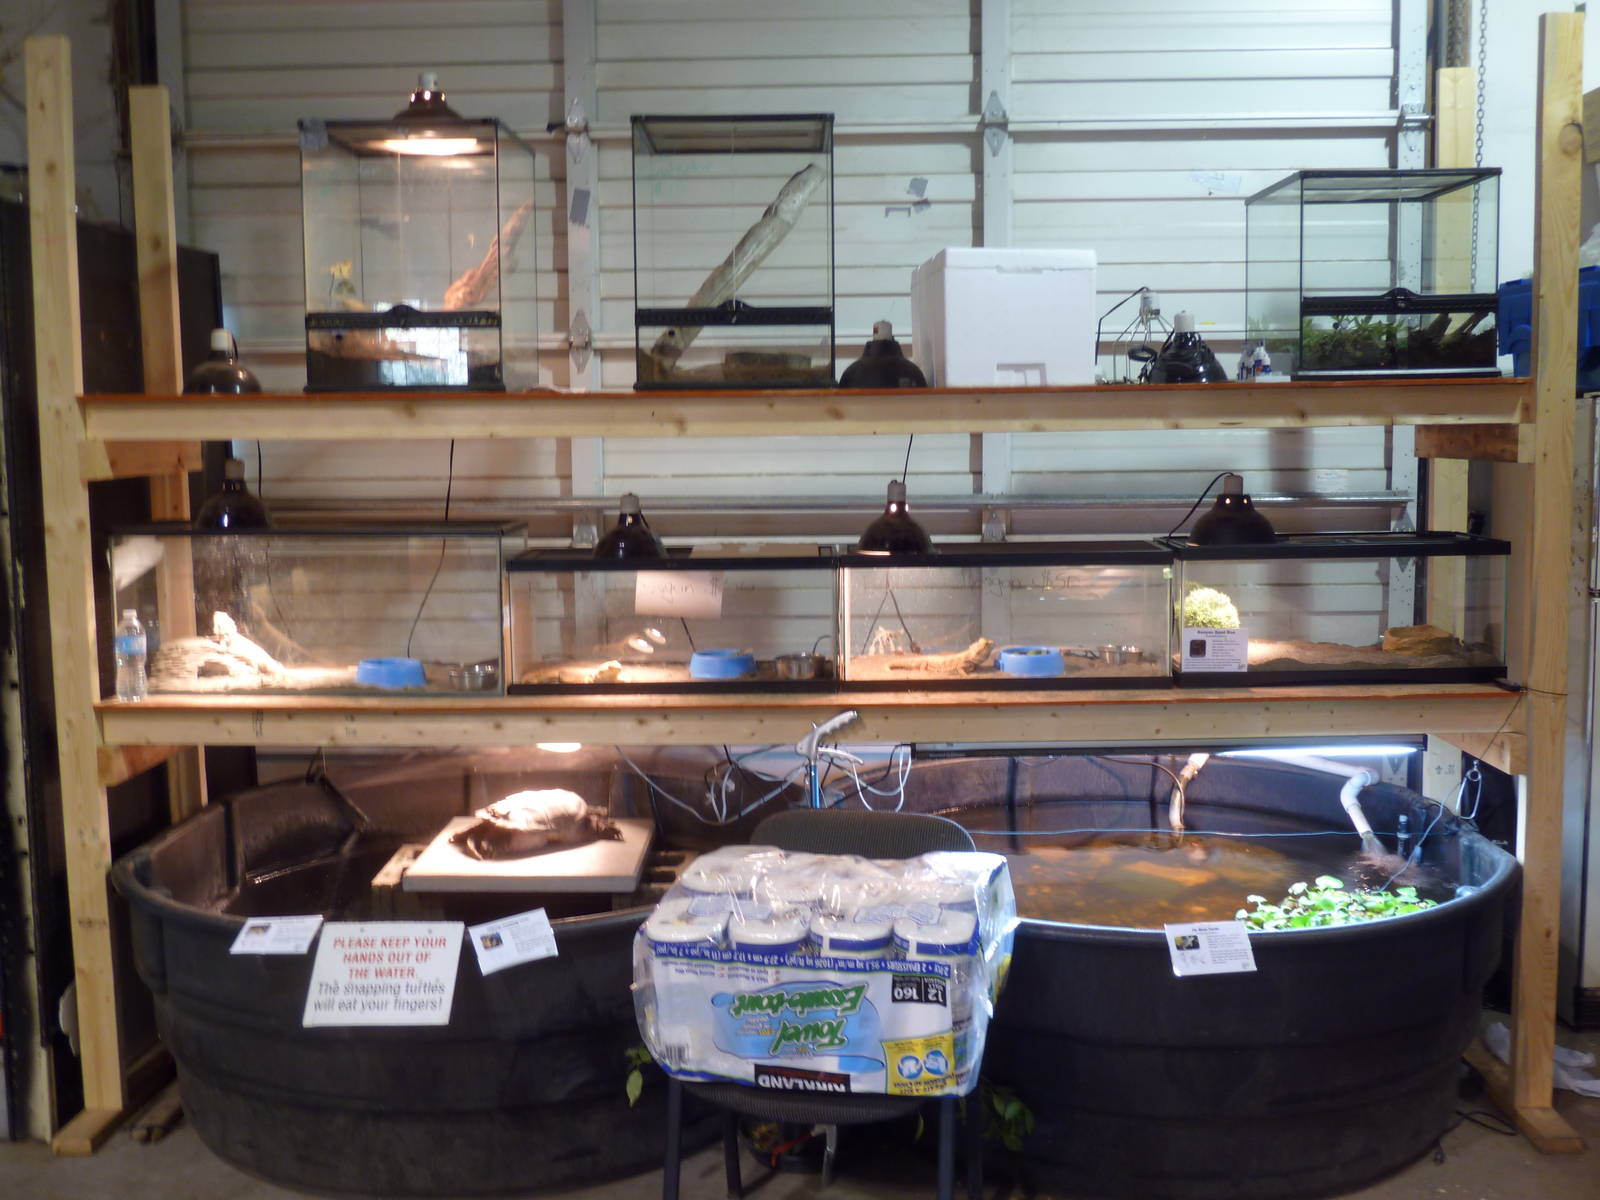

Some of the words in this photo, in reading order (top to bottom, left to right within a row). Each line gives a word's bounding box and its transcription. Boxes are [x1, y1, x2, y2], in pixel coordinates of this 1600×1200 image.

[333, 936, 376, 949] PLEASE
[380, 936, 410, 948] KEEP
[415, 936, 447, 948] YOUR
[343, 952, 384, 964] HANDS
[388, 952, 411, 963] OUT
[415, 952, 431, 963] OF
[348, 967, 369, 979] THE
[318, 980, 340, 994] The
[343, 981, 401, 997] snapping
[405, 980, 446, 994] turtles
[893, 986, 920, 1000] 160
[928, 990, 944, 1002] 12
[314, 998, 335, 1011] will
[338, 998, 357, 1011] eat
[361, 1000, 390, 1013] your
[393, 997, 443, 1014] fingers!
[769, 1018, 848, 1057] Towel
[757, 1074, 846, 1093] KIRKLAND
